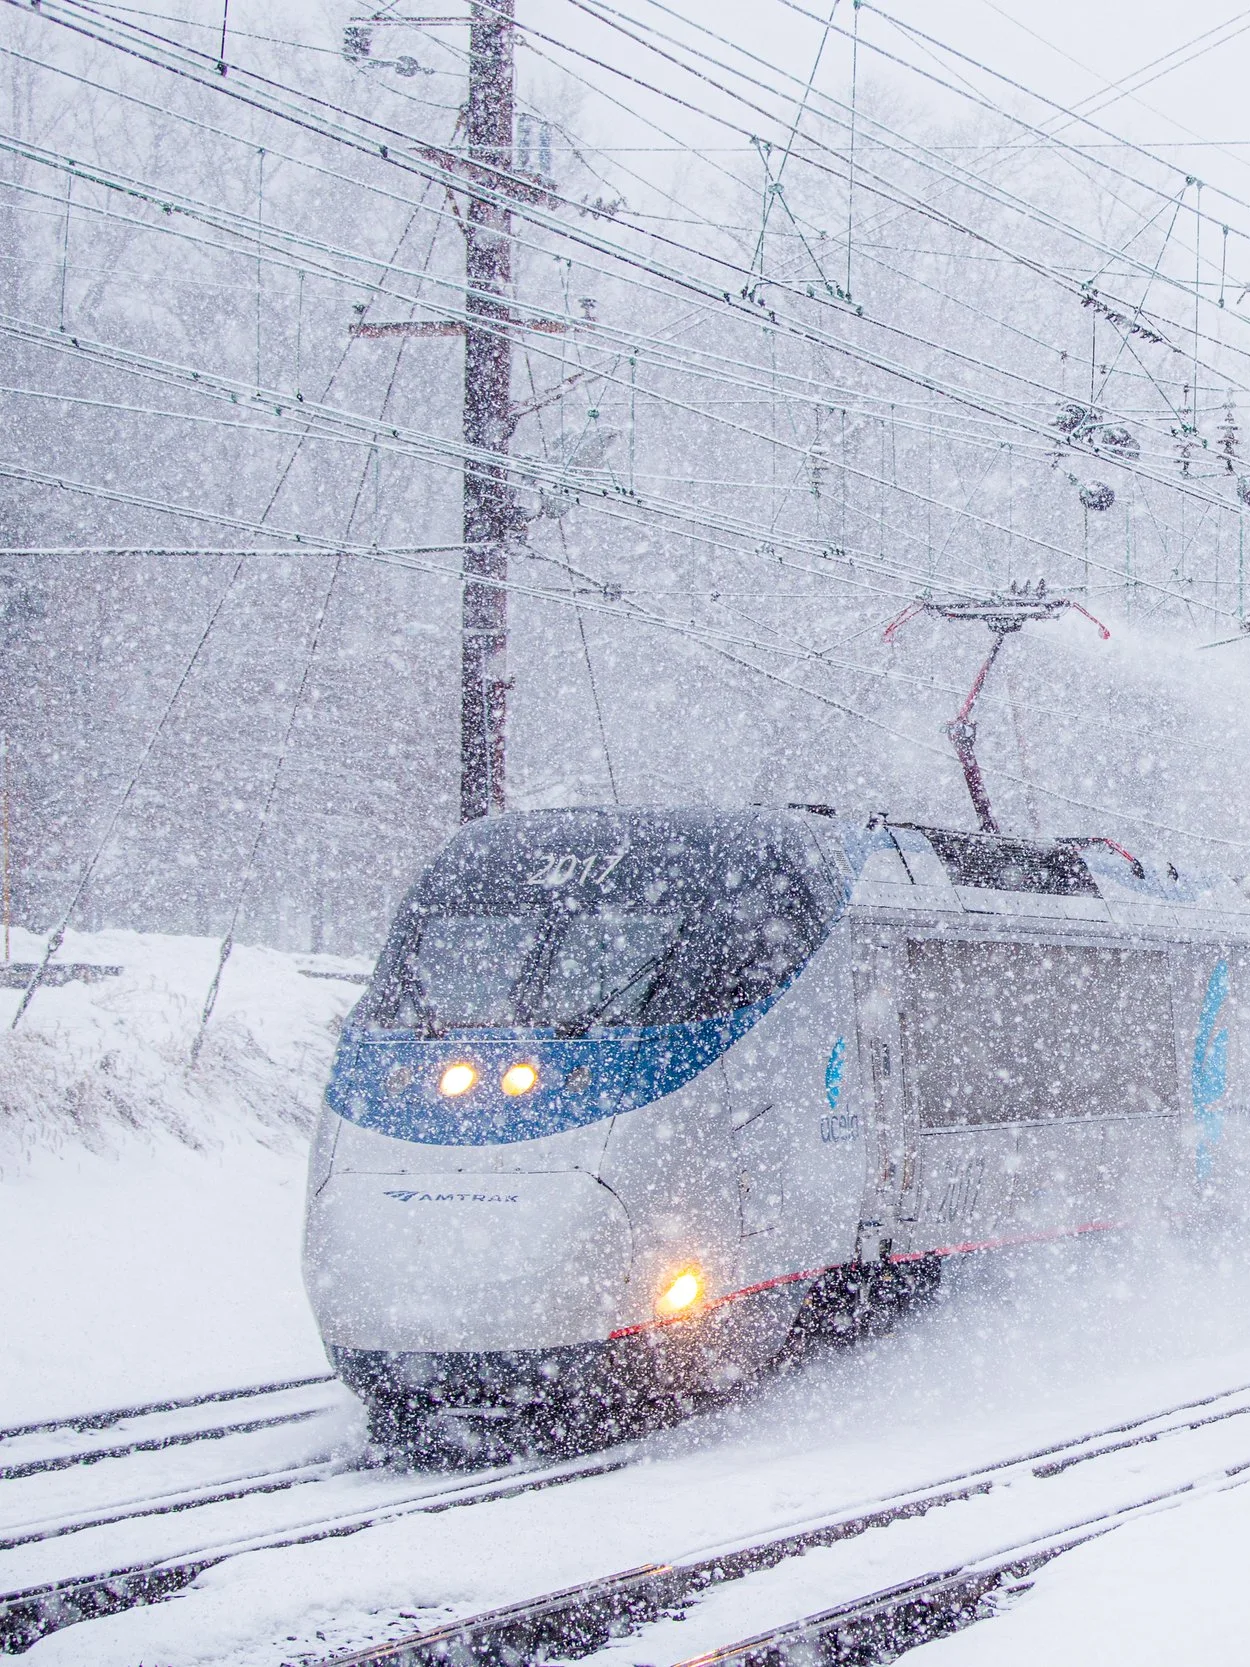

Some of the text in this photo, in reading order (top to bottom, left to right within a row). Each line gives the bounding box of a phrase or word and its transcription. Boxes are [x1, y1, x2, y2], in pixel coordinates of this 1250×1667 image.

[527, 854, 624, 886] 2017
[820, 1103, 860, 1143] acela
[419, 1193, 519, 1203] AMTRAK
